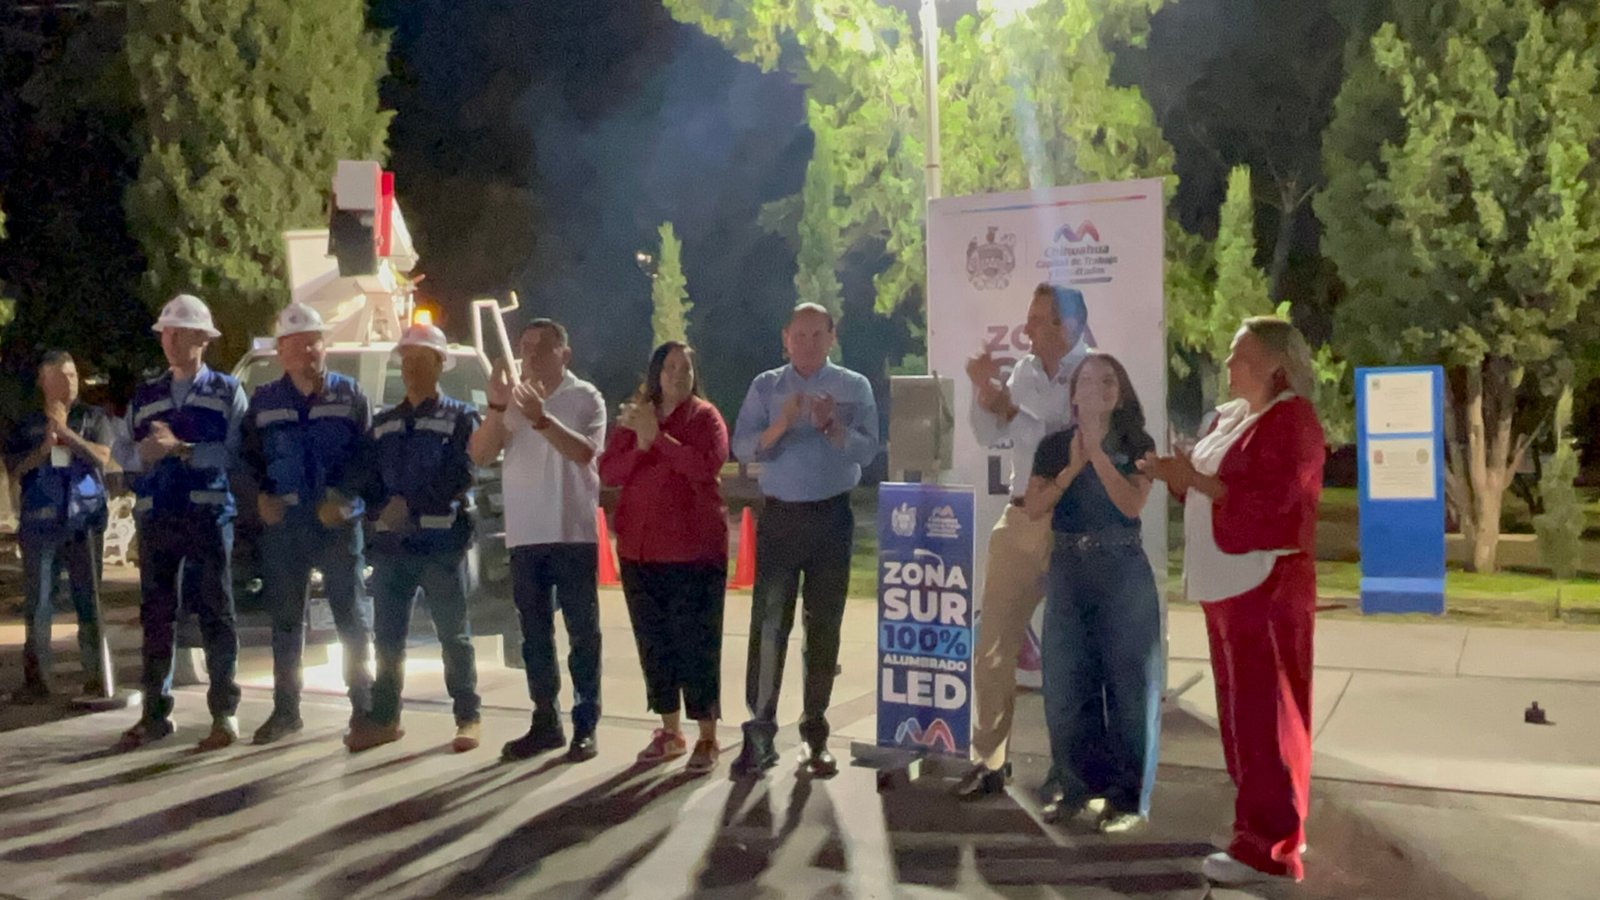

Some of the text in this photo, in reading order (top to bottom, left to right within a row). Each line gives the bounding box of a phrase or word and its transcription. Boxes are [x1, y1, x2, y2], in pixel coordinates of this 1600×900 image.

[1044, 245, 1109, 257] Chihuahua
[883, 562, 967, 589] ZONA
[883, 587, 967, 626] SUR
[883, 624, 967, 656] 100%
[883, 653, 967, 672] ALUMBRADO
[882, 668, 967, 709] LED
